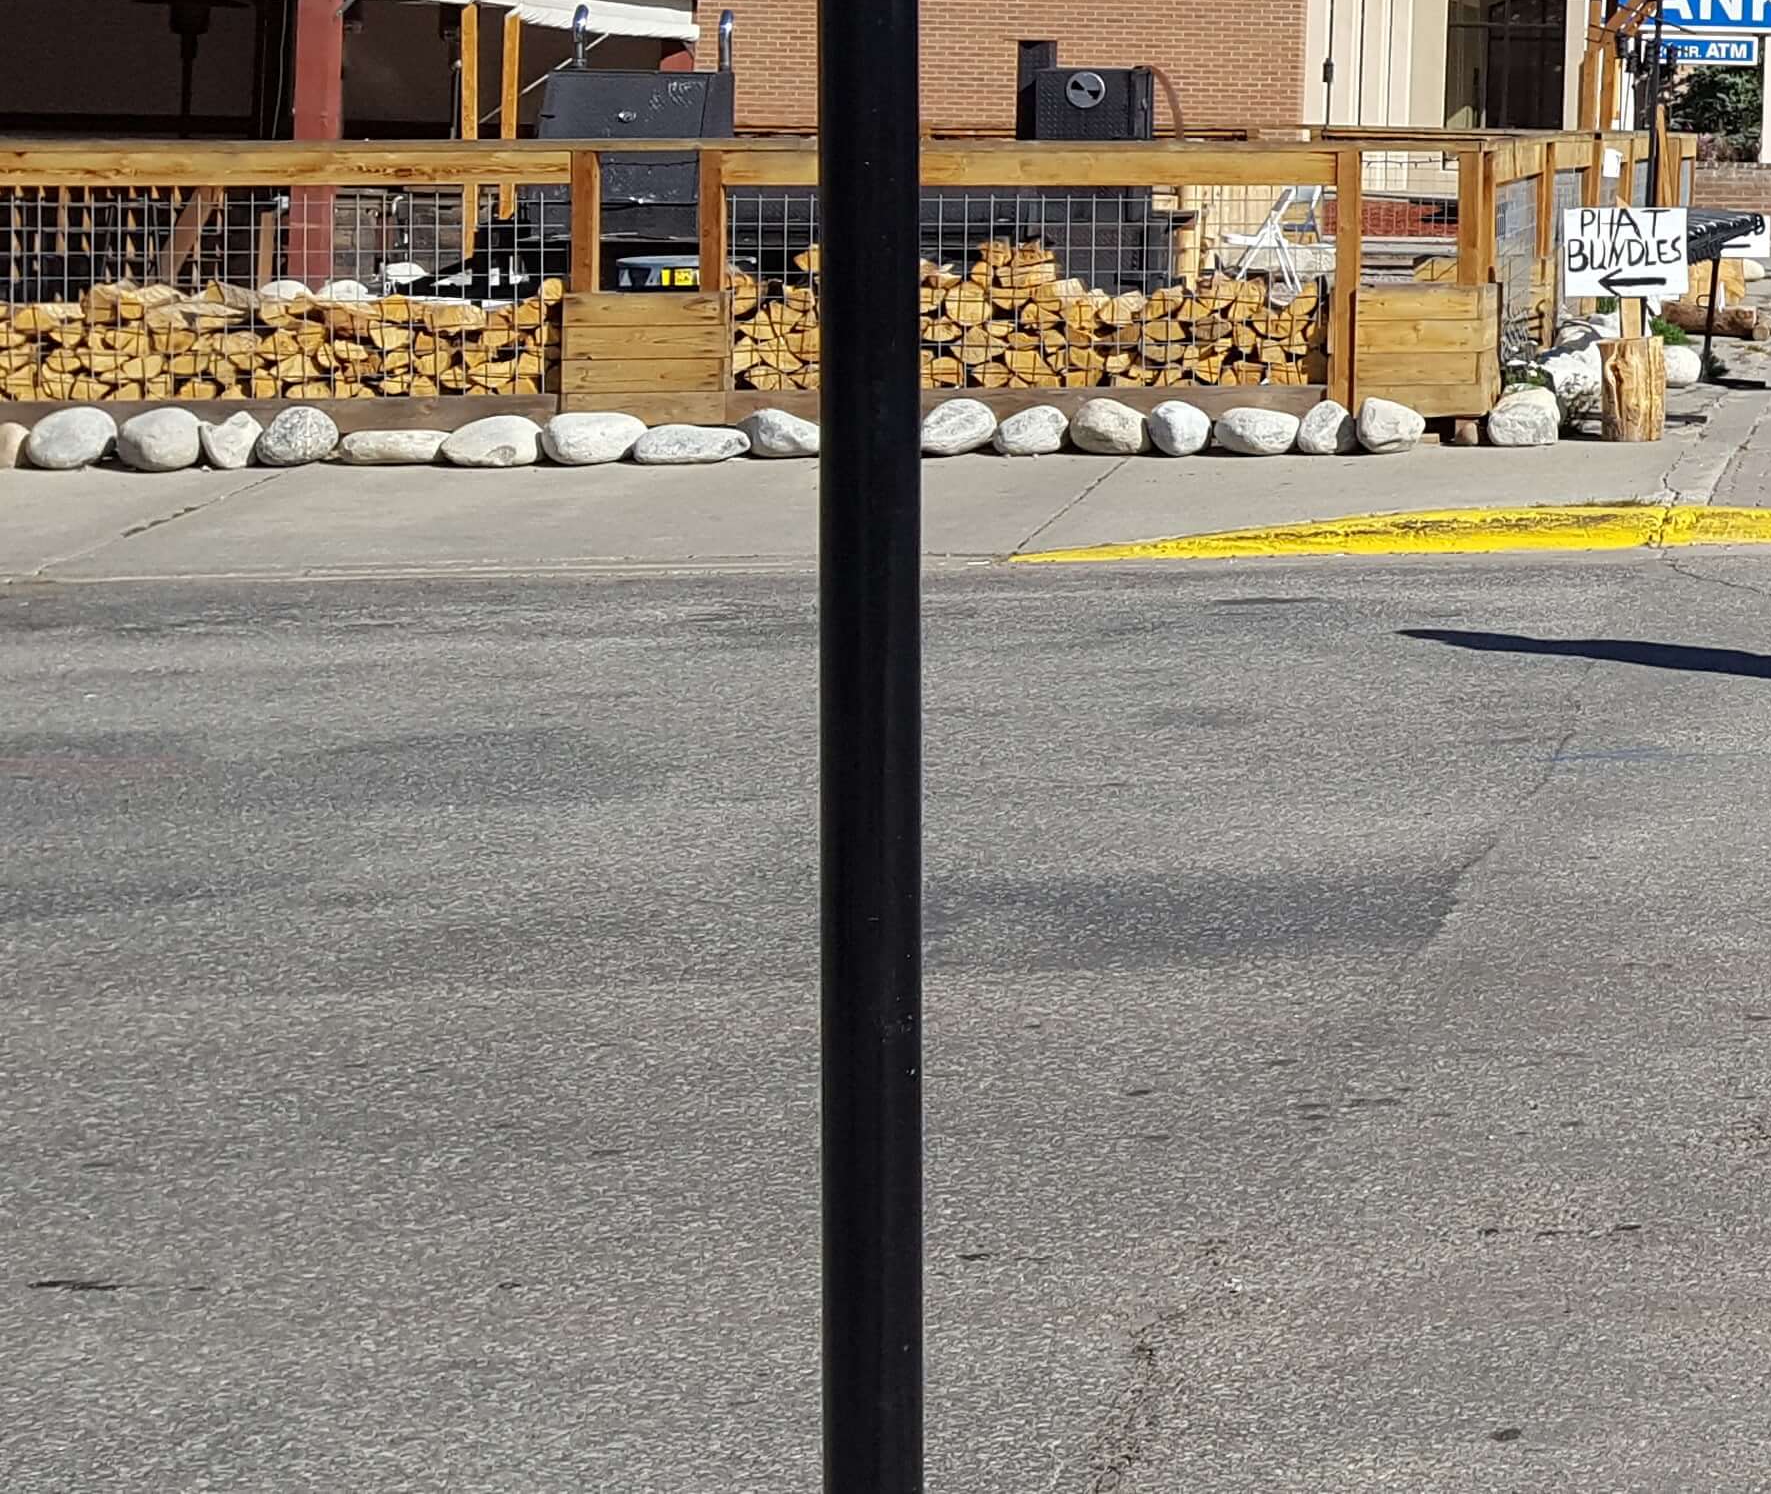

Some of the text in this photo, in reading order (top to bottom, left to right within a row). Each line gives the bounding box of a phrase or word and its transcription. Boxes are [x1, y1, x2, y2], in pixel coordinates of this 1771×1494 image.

[1705, 43, 1748, 58] ATM
[1580, 208, 1671, 239] PHAT
[1567, 236, 1682, 272] BUNDLES
